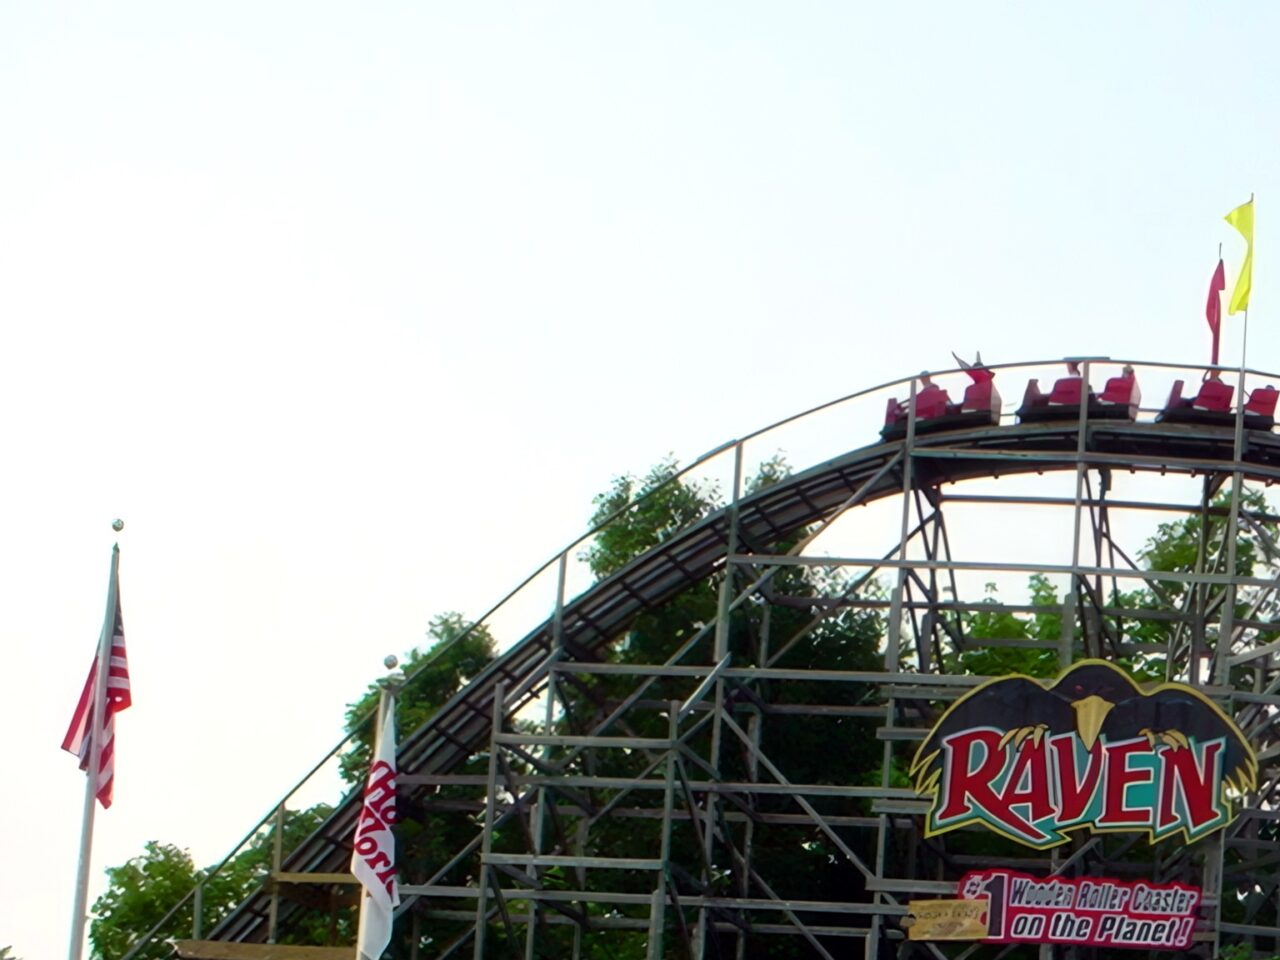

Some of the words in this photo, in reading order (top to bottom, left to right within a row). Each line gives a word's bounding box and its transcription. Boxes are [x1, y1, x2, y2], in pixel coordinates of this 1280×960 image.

[936, 728, 1224, 841] RAVEN
[1010, 878, 1073, 907] Wooden
[1078, 882, 1129, 910] Roller
[1132, 886, 1195, 912] Coaster
[1012, 915, 1045, 936] on
[1050, 912, 1092, 938] the
[1097, 915, 1191, 944] Planet!
